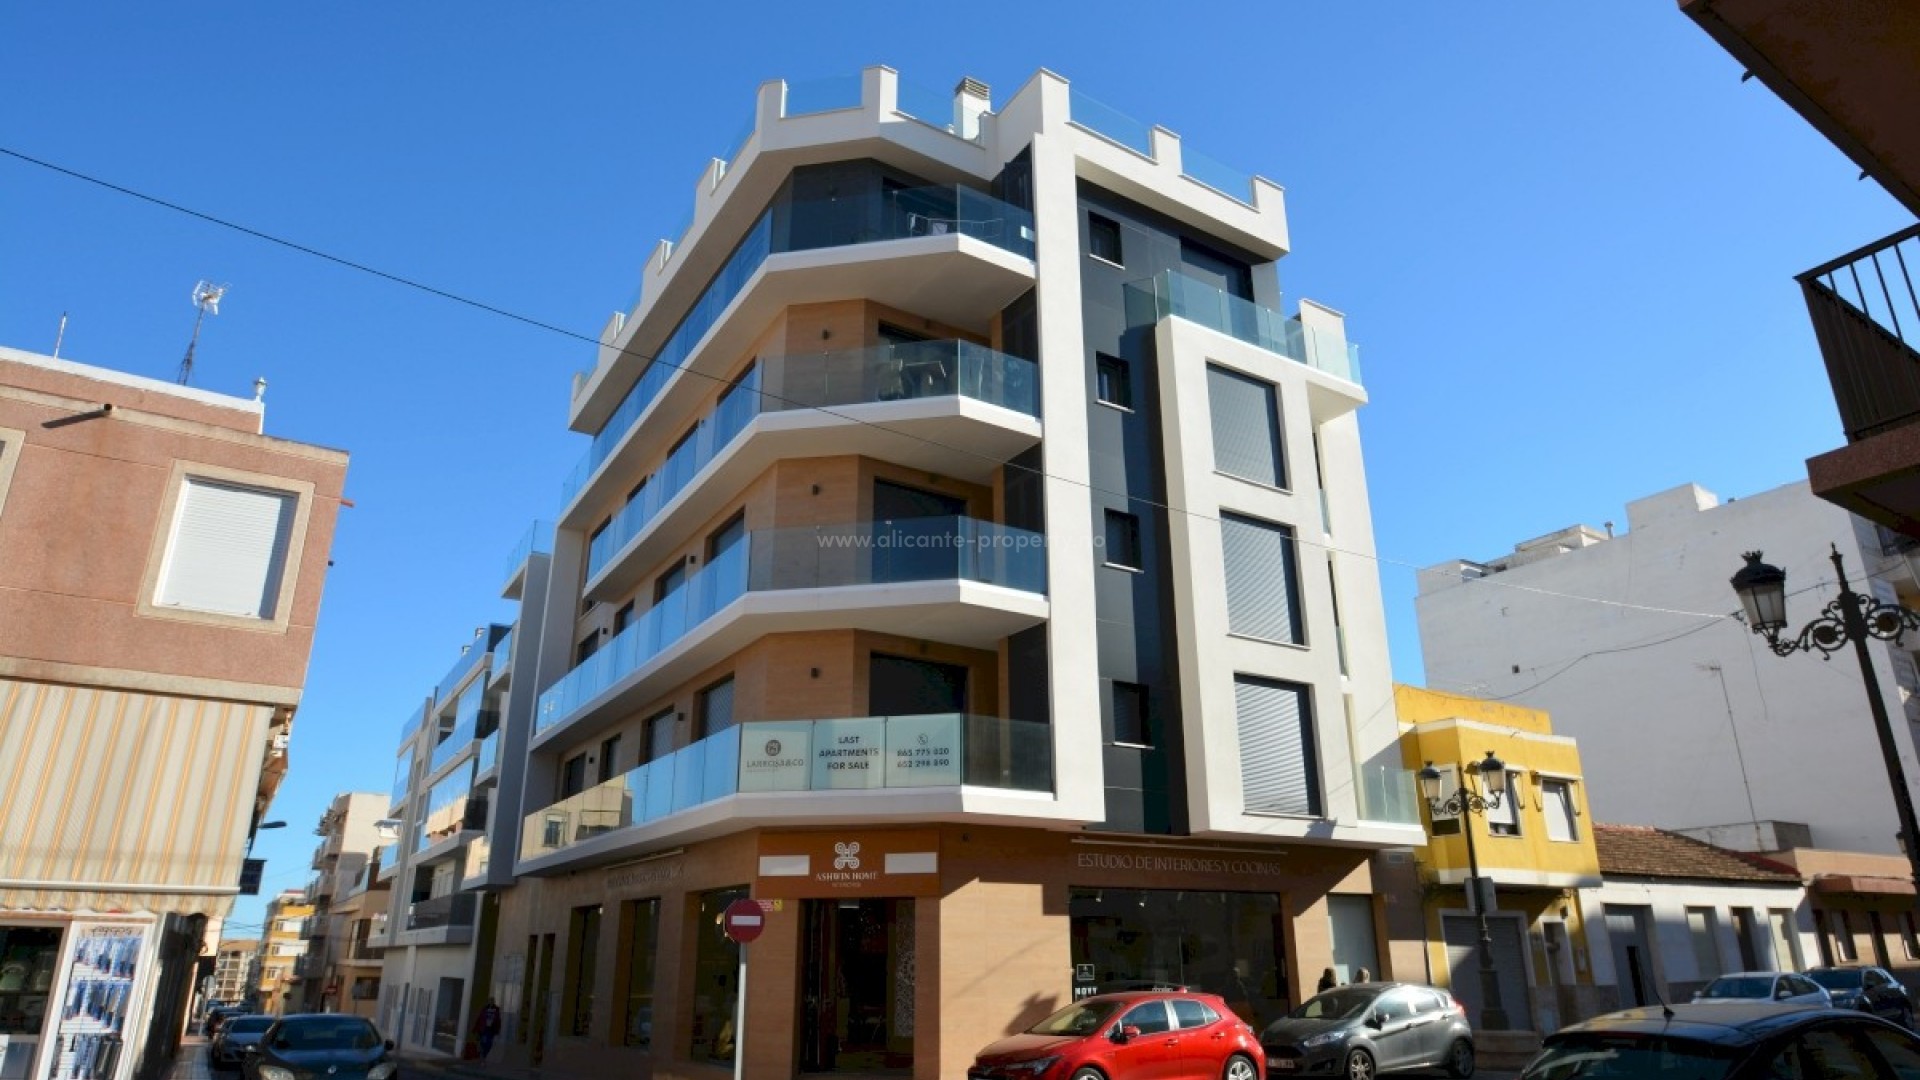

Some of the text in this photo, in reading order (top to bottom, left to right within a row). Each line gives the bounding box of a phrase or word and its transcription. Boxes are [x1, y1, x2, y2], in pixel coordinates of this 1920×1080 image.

[838, 736, 860, 744] LAST
[818, 748, 880, 758] APARTMENTS
[827, 761, 870, 770] FOR SALE
[1078, 853, 1132, 869] ESTUDIO
[1135, 856, 1153, 870] DE
[1154, 857, 1220, 873] INTERIORES
